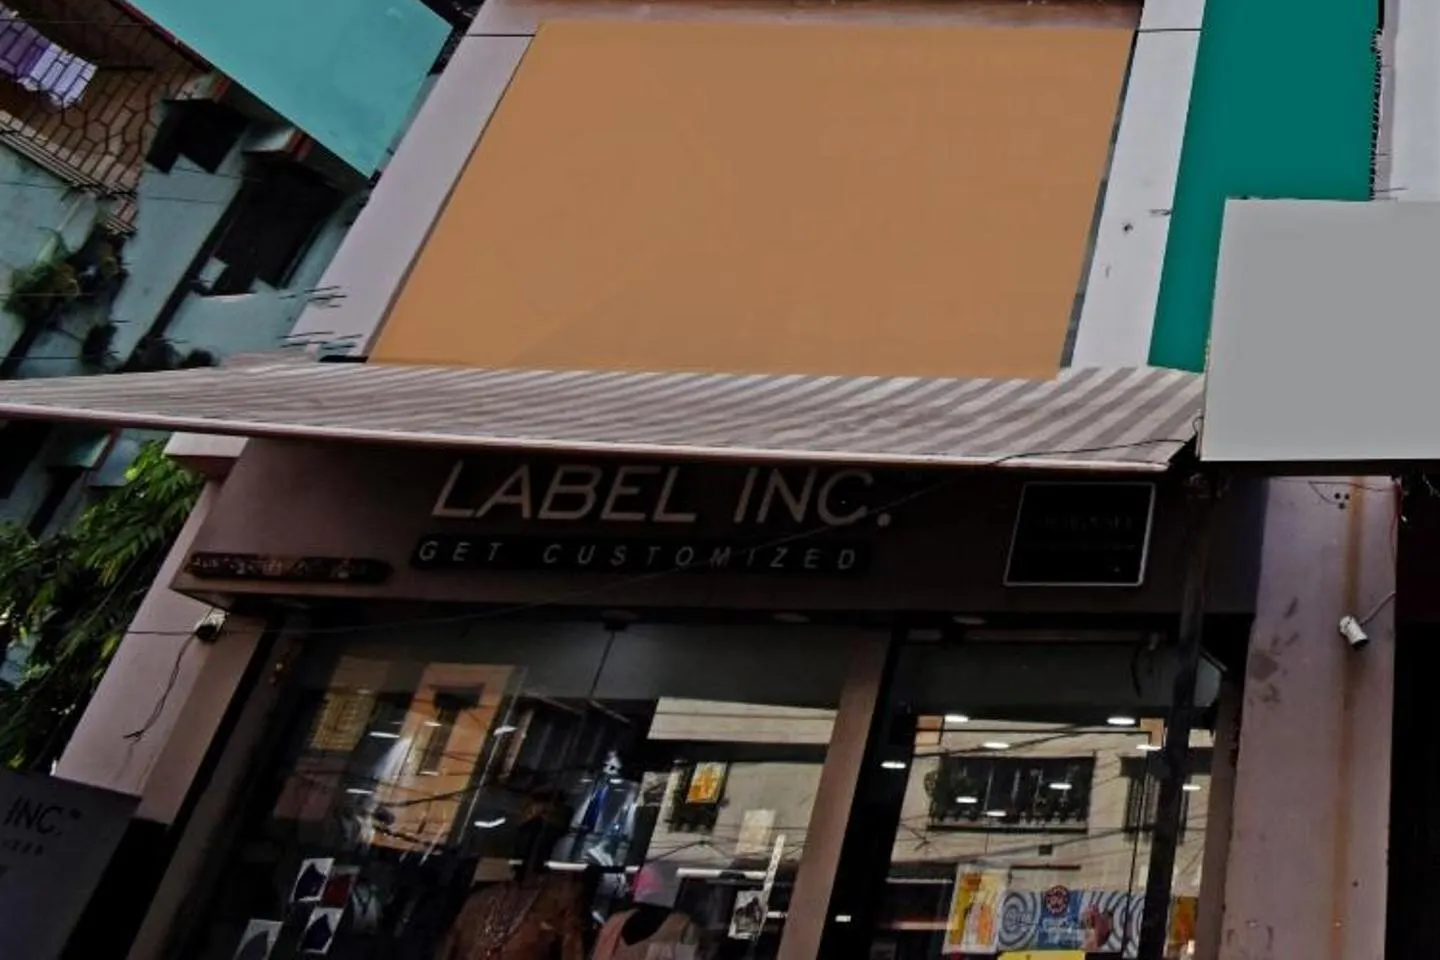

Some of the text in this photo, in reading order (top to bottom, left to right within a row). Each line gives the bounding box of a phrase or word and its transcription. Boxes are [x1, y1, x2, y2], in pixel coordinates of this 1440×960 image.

[431, 461, 893, 528] LABEL INC.
[418, 541, 857, 570] GET CUSTOMIZED
